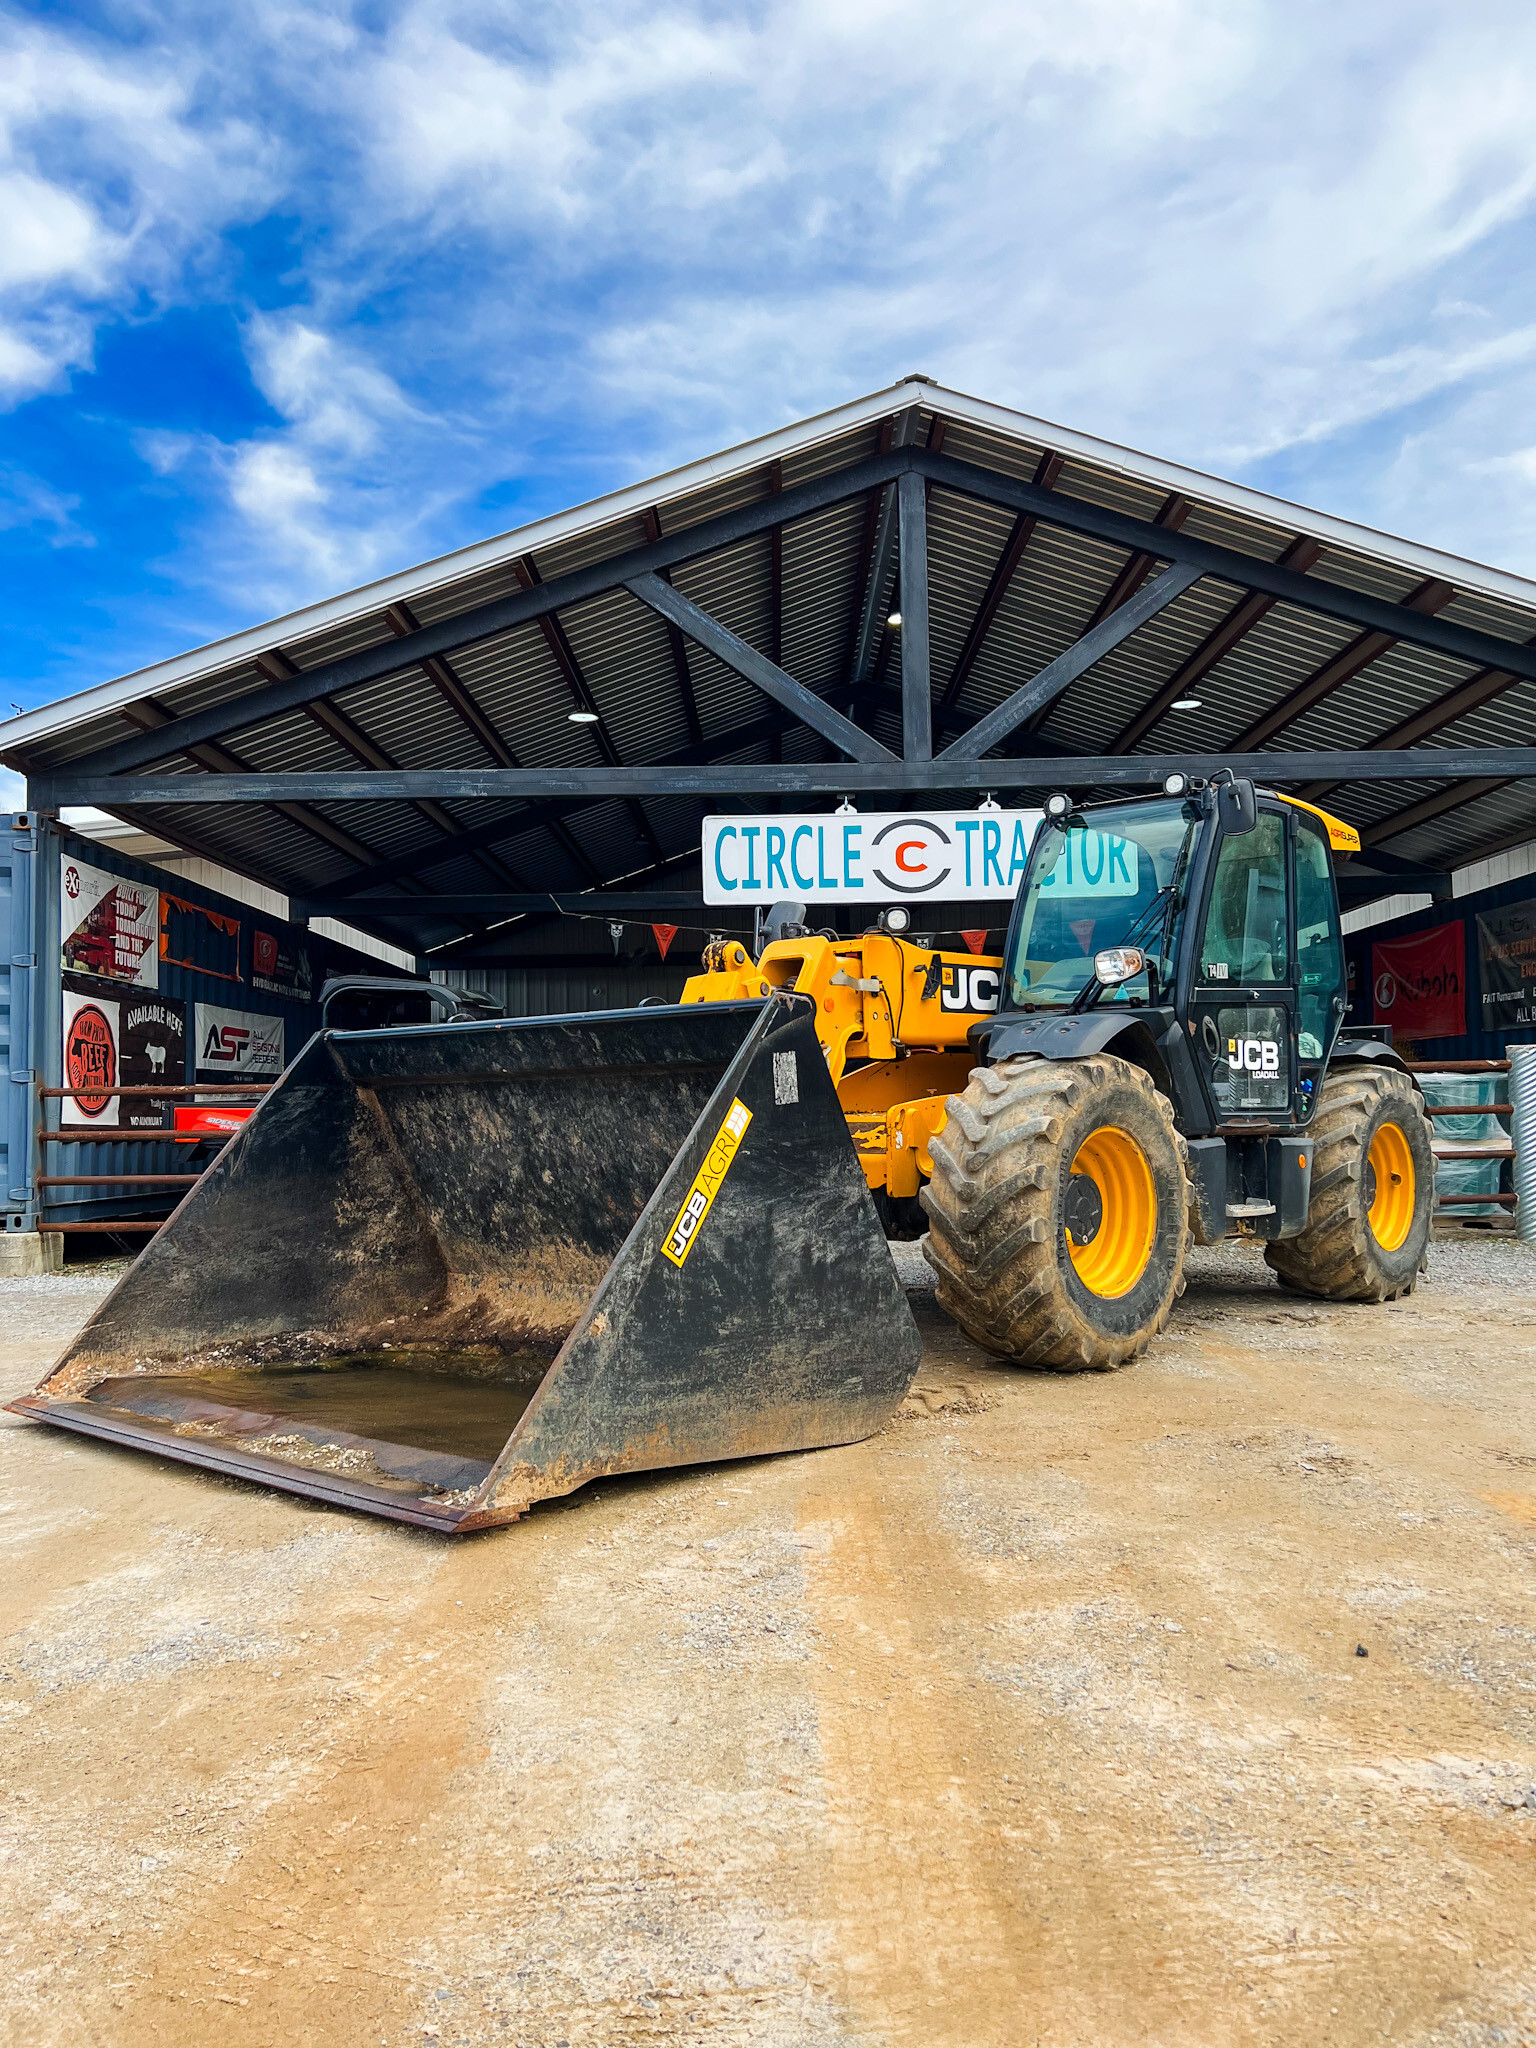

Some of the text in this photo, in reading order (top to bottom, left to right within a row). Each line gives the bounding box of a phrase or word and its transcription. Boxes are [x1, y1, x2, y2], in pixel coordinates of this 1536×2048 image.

[715, 819, 1131, 891] CIRCLE C TRATOR
[116, 883, 148, 906] BUILT FOR
[116, 900, 137, 919] TODAY
[115, 916, 156, 940] TOMORROW
[115, 933, 144, 954] AND THE
[115, 950, 141, 970] FUTURE
[942, 968, 999, 1011] JC
[1401, 965, 1459, 1002] Kubota
[127, 1005, 184, 1037] AVAILABLE HERE
[202, 1024, 250, 1061] ASF
[253, 1030, 264, 1040] ALL
[80, 1043, 107, 1072] BEEF
[252, 1042, 280, 1053] SEASONS
[252, 1053, 279, 1065] FEEDERS
[1229, 1039, 1279, 1071] JCB
[1252, 1070, 1279, 1080] LOADALL
[205, 1117, 244, 1128] SIDEKIC
[674, 1130, 737, 1257] JCB AGRI
